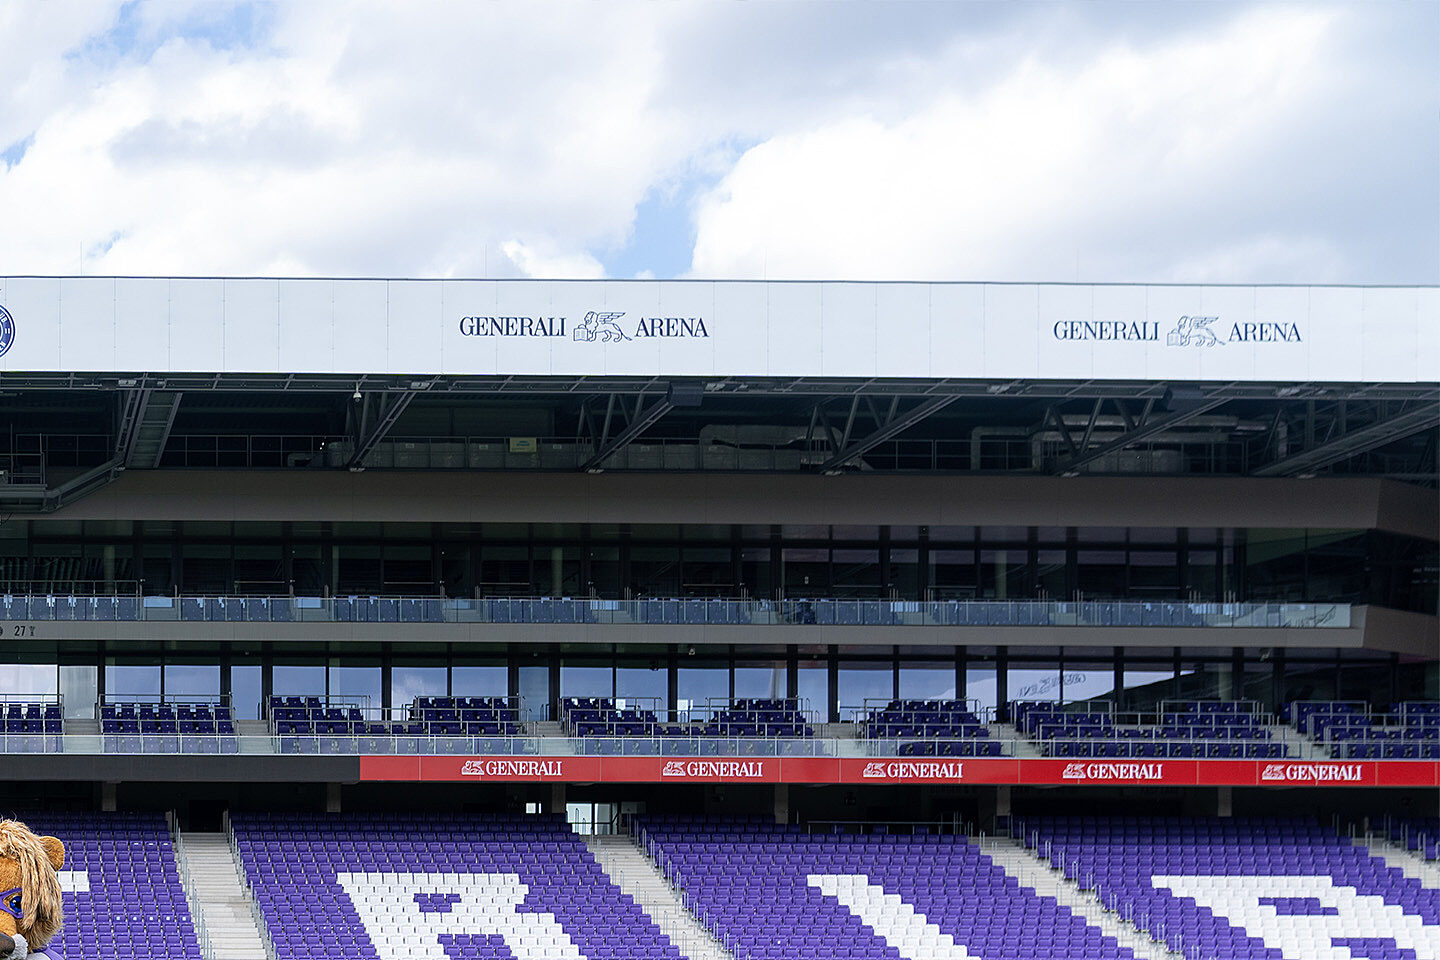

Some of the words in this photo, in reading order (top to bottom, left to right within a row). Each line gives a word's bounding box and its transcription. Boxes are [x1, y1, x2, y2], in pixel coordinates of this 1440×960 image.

[460, 317, 566, 336] GENERALI
[635, 318, 709, 337] ARENA
[1054, 321, 1159, 340] GENERALI
[1229, 323, 1301, 341] ARENA
[14, 625, 26, 636] 27
[486, 760, 563, 776] GENERALI
[686, 762, 763, 777] GENERALI
[887, 762, 964, 778] GENERALI
[1086, 763, 1163, 779] GENERALI
[1285, 765, 1363, 780] GENERALI
